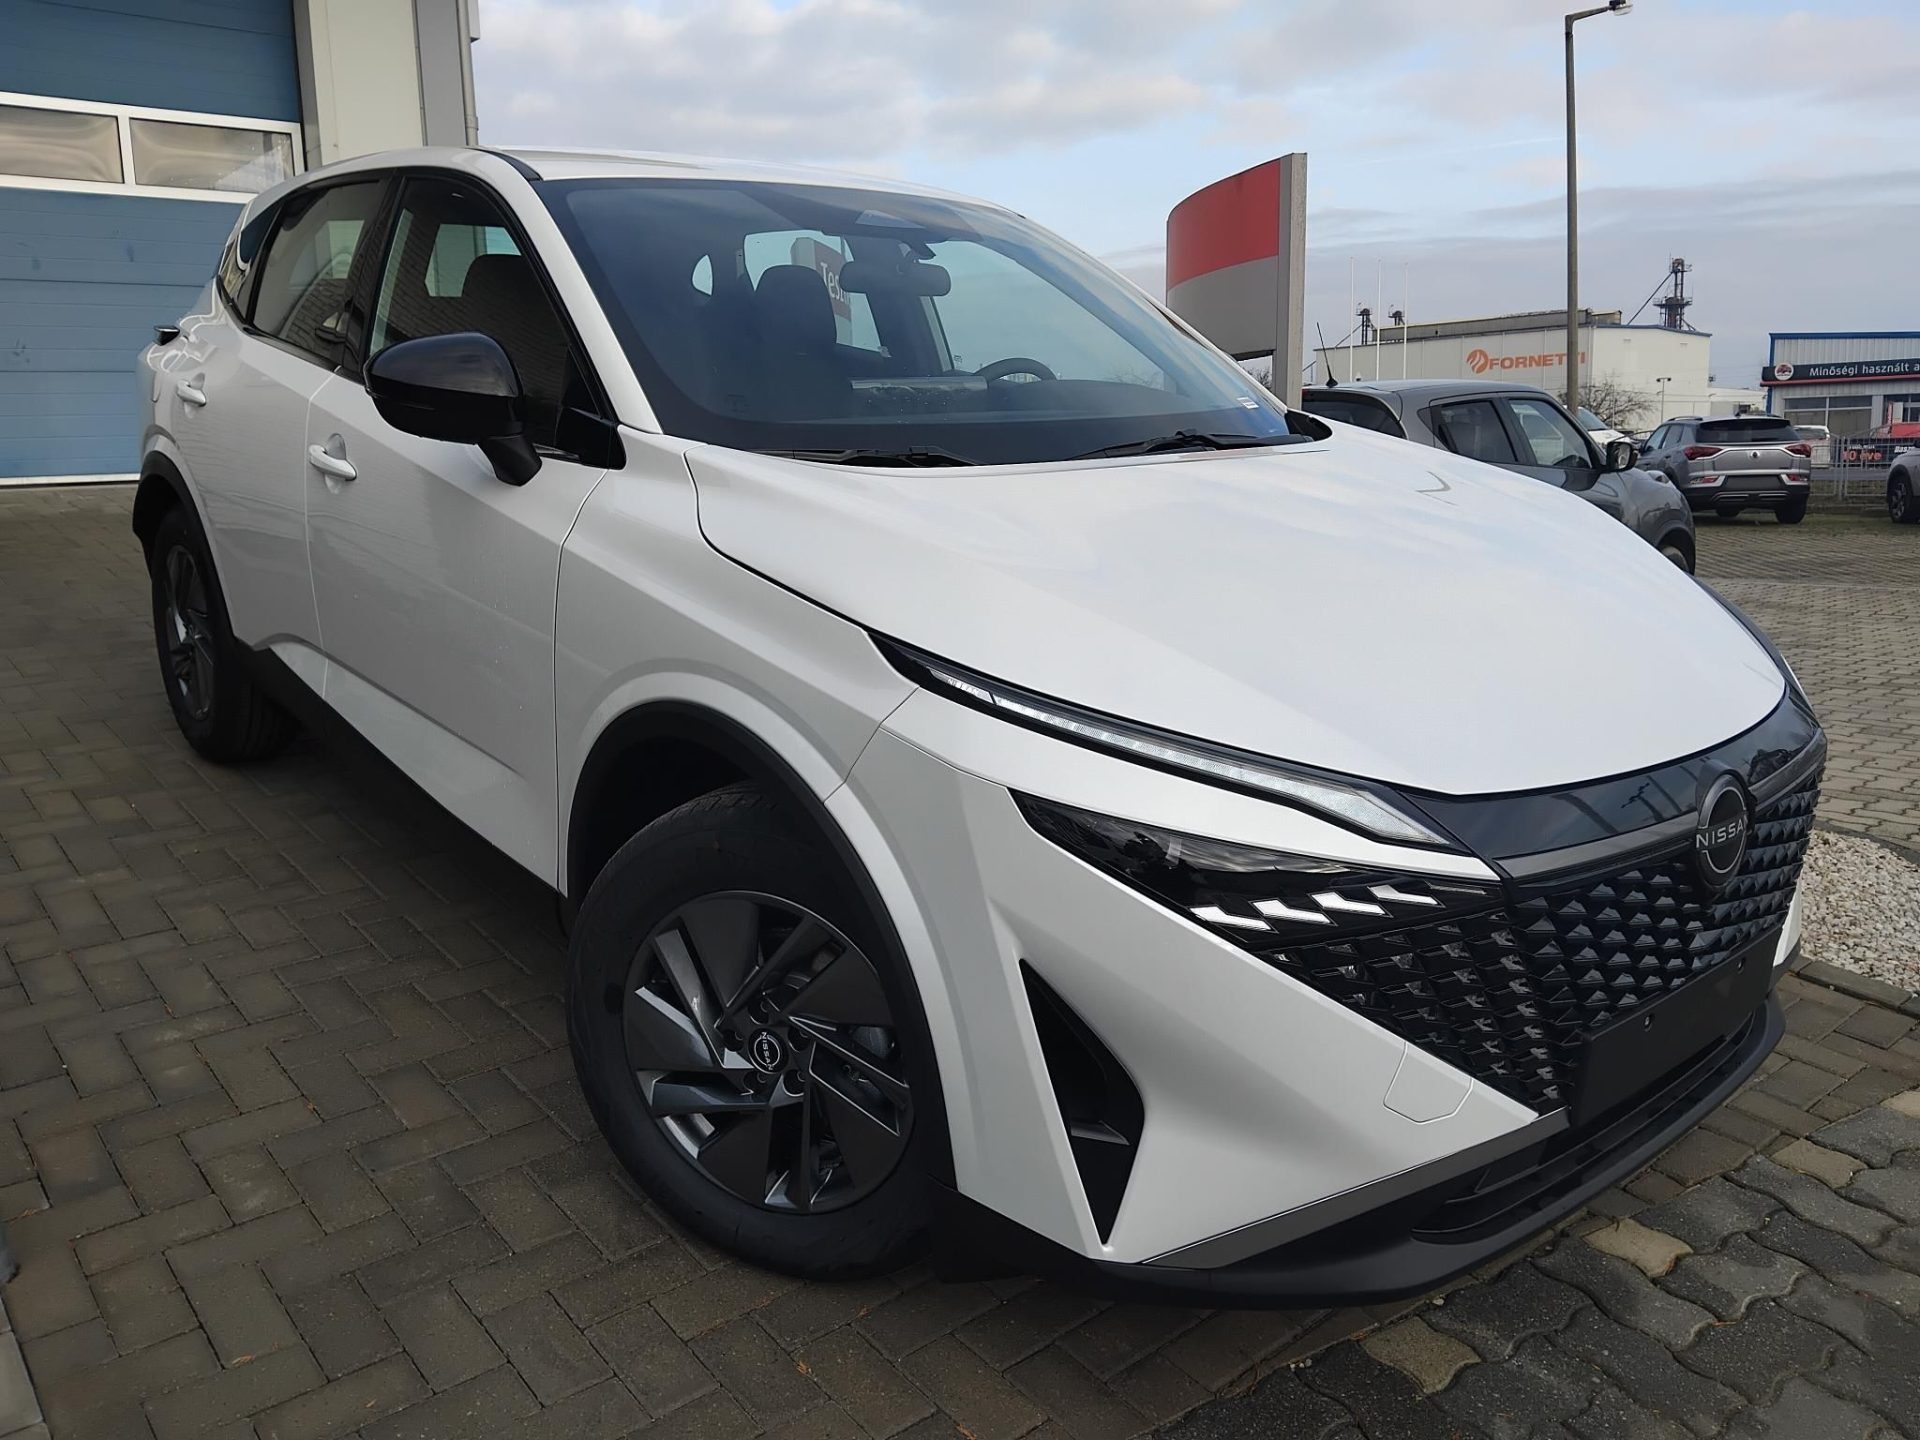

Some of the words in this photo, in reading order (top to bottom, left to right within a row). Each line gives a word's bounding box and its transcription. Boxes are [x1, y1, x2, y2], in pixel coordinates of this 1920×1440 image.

[1489, 352, 1585, 370] FORNETI
[1809, 366, 1858, 377] Minőségi
[1862, 362, 1909, 374] használt
[761, 1032, 773, 1070] NISSAN
